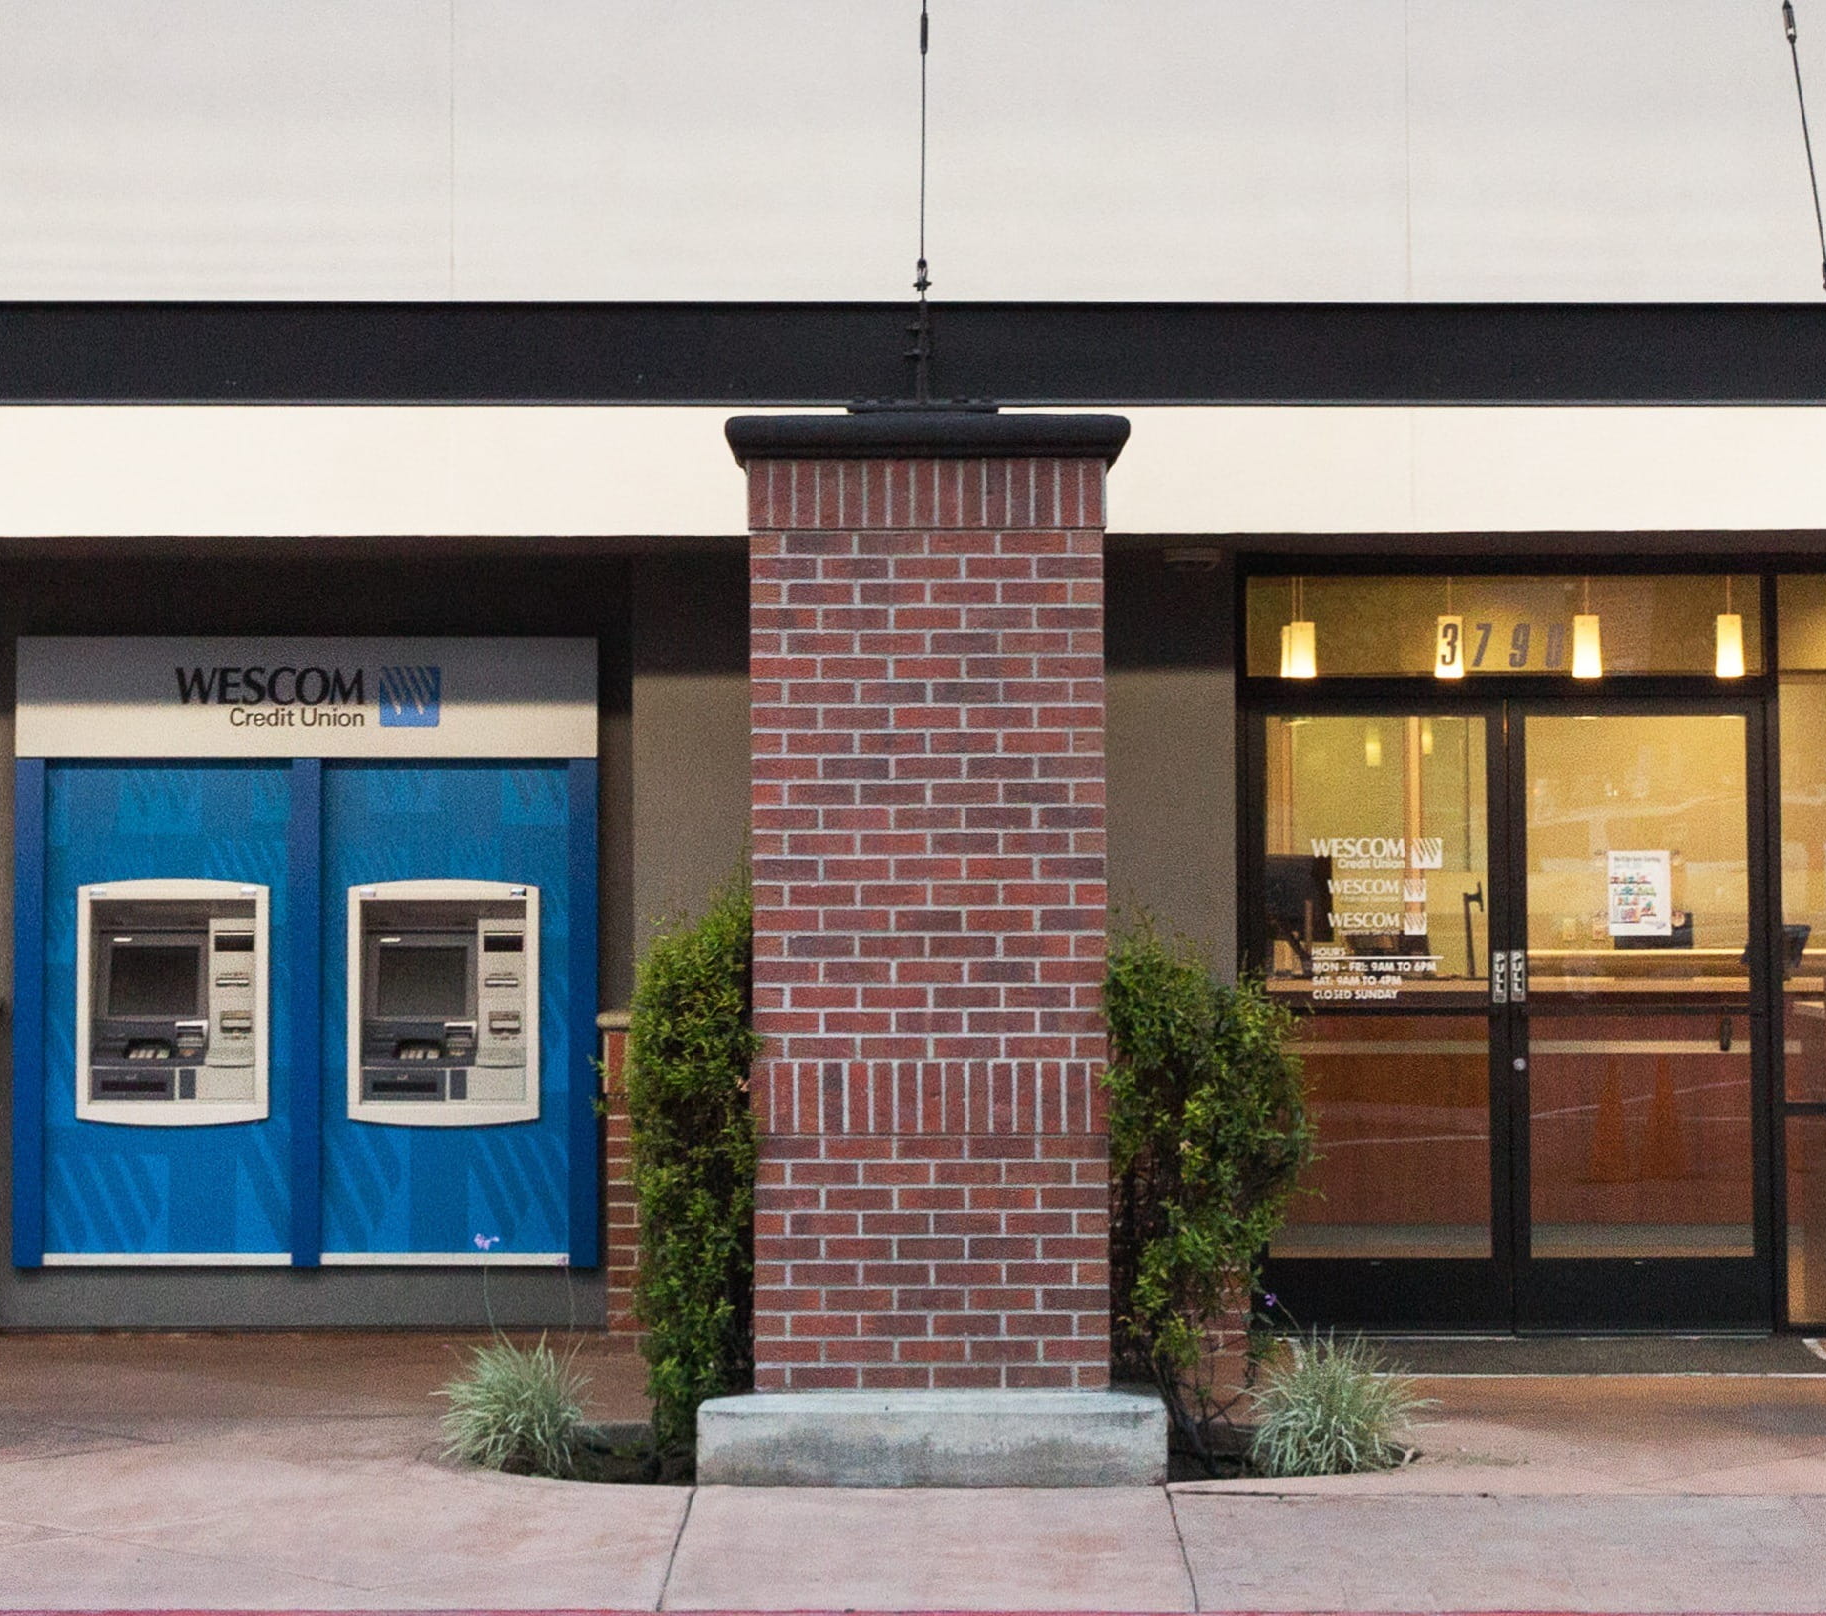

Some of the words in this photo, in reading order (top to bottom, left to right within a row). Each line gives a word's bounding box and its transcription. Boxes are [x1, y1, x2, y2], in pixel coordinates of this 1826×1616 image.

[175, 665, 365, 705] WESCOM
[229, 707, 295, 727] Credit
[300, 707, 365, 727] Union
[1311, 837, 1405, 858] WESCOM
[1338, 858, 1370, 869] Credit
[1374, 859, 1405, 869] Union
[1327, 879, 1399, 894] WESCOM
[1327, 912, 1400, 928] WESCOM
[1312, 962, 1339, 972] MON
[1370, 962, 1394, 972] 9AM
[1398, 962, 1412, 972] TO
[1495, 953, 1504, 992] PULL
[1513, 951, 1522, 991] PULL
[1336, 976, 1360, 986] 9AM
[1362, 976, 1377, 986] TO
[1312, 989, 1352, 1000] CLOSED
[1354, 989, 1398, 1000] SUNDAY
